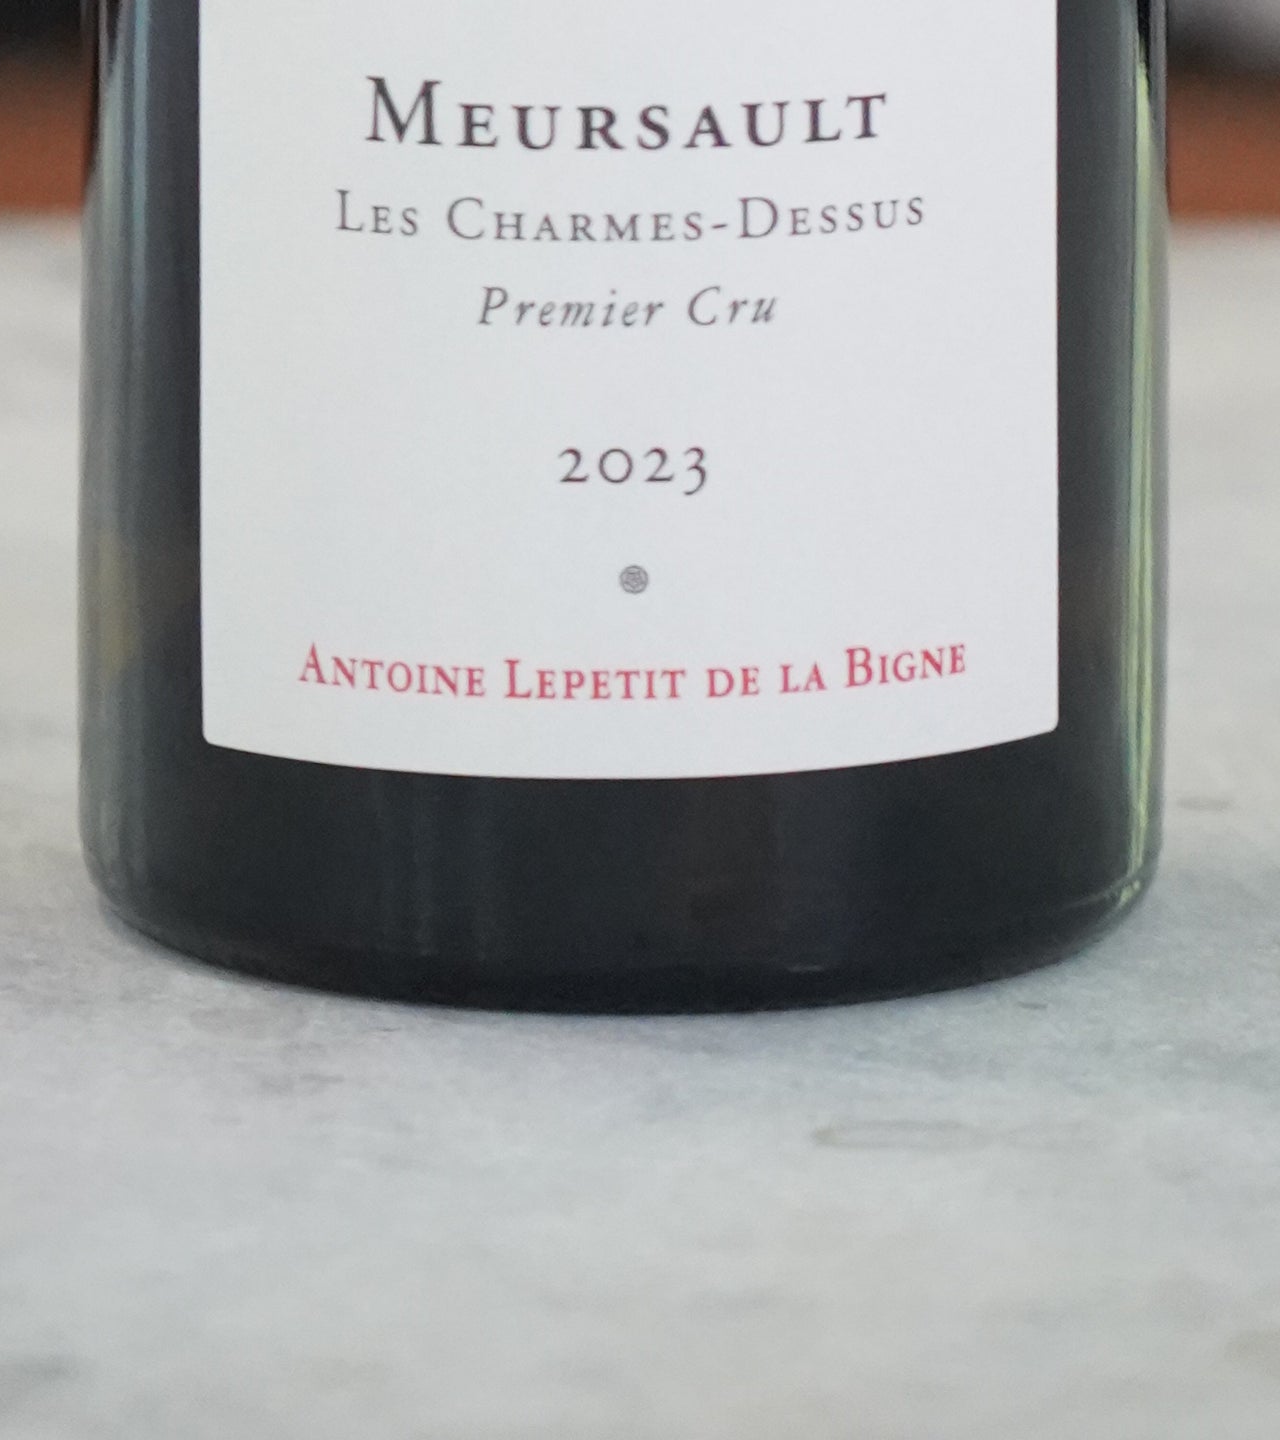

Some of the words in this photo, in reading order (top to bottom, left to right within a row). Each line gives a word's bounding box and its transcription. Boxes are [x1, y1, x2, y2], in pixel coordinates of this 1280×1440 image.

[364, 74, 888, 152] MEURSAULT
[335, 188, 420, 237] LES
[445, 196, 925, 243] CHARMES-DESSUS
[477, 286, 666, 328] Premier
[687, 285, 777, 327] Cru
[558, 445, 709, 497] 2023
[298, 642, 486, 698] ANTOINE
[503, 658, 687, 701] LEPETIT
[705, 666, 760, 699] DE
[779, 661, 828, 694] LA
[844, 643, 967, 689] BIGNE
